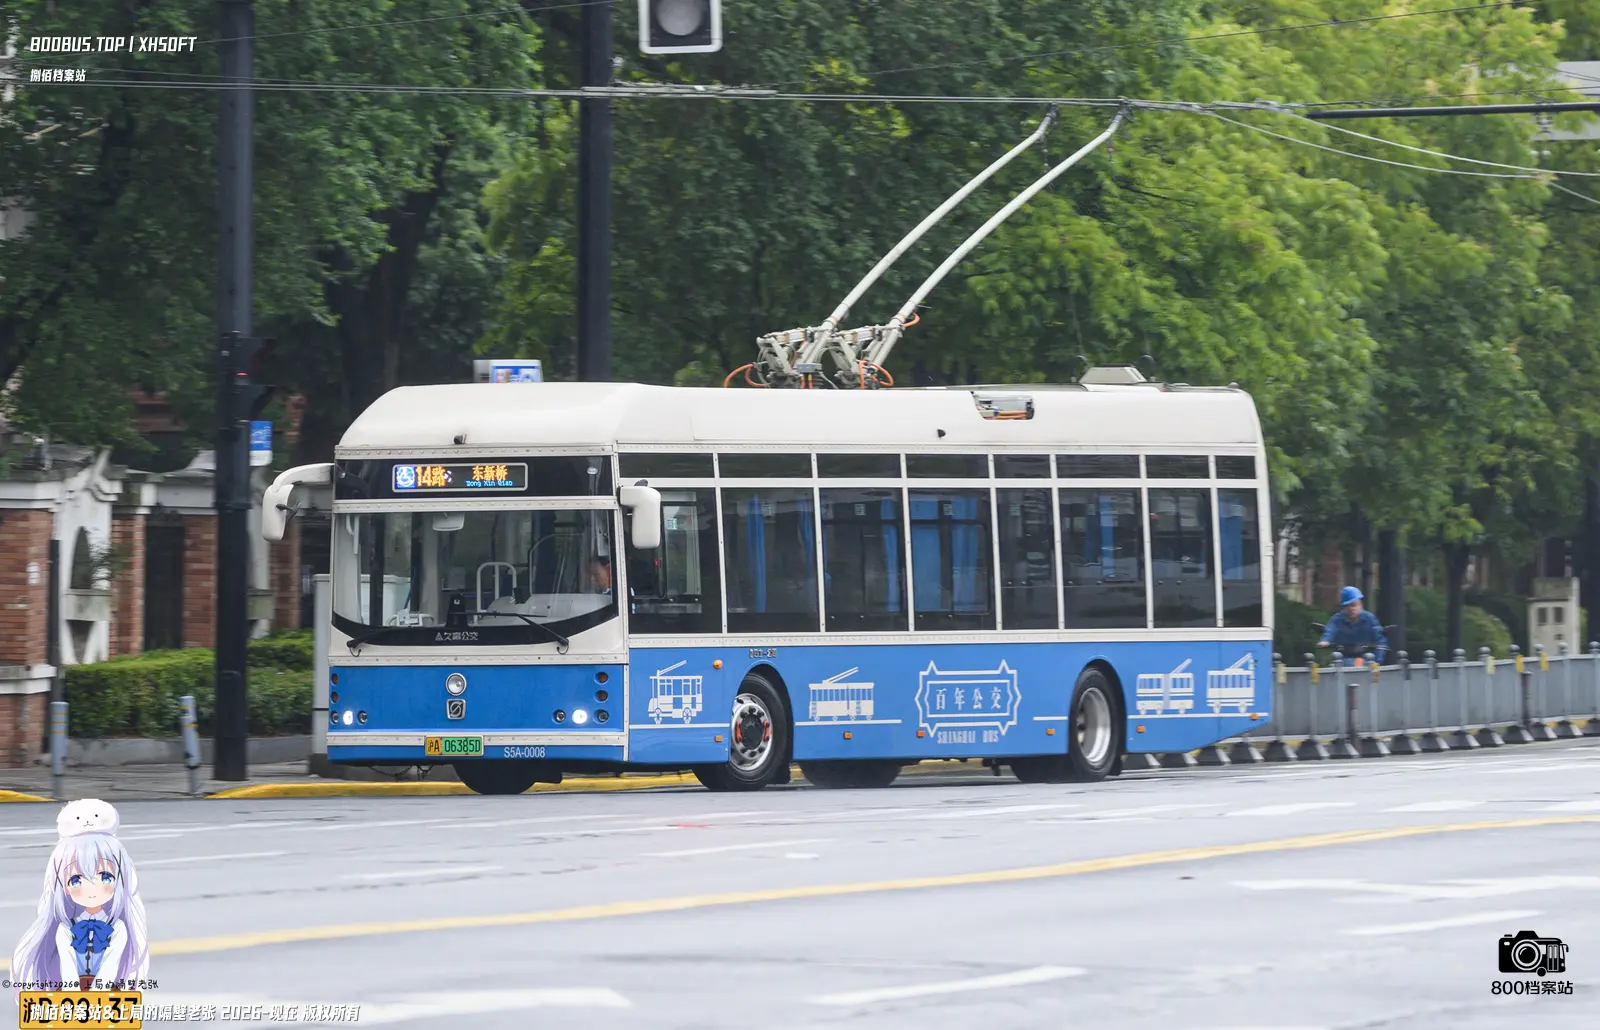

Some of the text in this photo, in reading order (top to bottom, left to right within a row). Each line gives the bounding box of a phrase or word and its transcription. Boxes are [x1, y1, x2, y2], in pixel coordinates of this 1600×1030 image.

[416, 465, 446, 487] 14路
[472, 465, 508, 481] 东新桥
[936, 686, 1002, 711] 百年公交
[504, 746, 546, 759] S5A-0008
